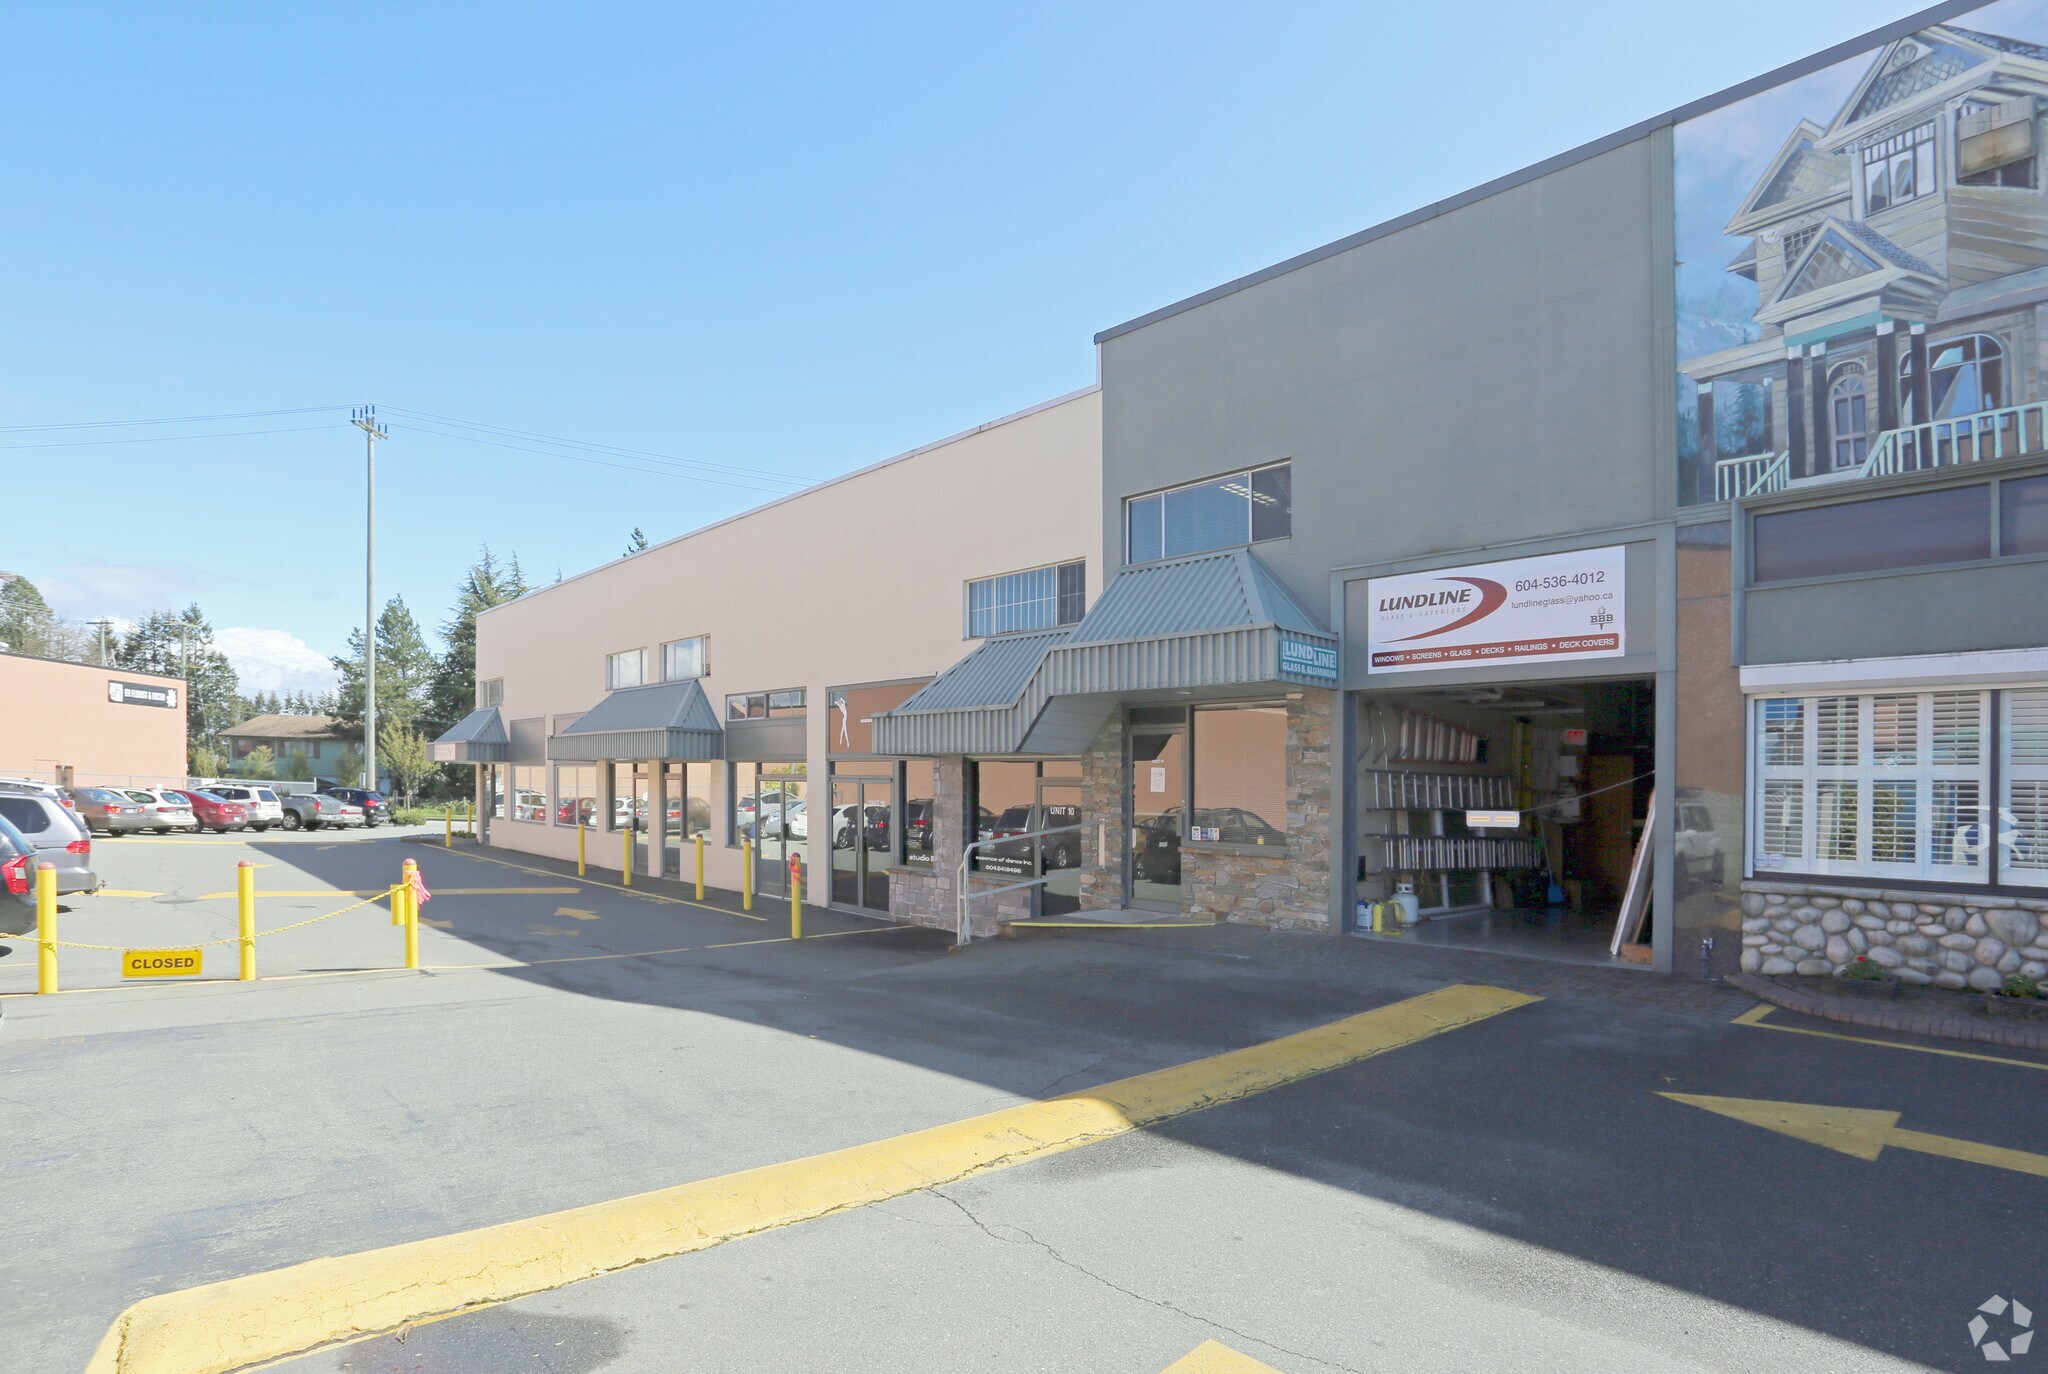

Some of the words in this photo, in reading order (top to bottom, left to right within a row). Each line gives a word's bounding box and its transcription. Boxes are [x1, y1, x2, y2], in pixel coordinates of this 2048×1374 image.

[1515, 570, 1605, 592] 604-536-4012
[1379, 589, 1472, 612] LUNDLINE
[1511, 592, 1614, 609] lundlineglass@yahoo.ca
[1380, 613, 1405, 621] GLASS
[1420, 606, 1467, 617] EXTERIORS
[1590, 614, 1614, 623] BBB
[1374, 654, 1405, 663] WINDOWS
[1412, 652, 1442, 661] SCREENS
[1450, 649, 1472, 657] GLASS
[1481, 646, 1505, 655] DECKS
[1514, 642, 1548, 652] RAILINGS
[1559, 640, 1580, 649] DECK
[1582, 638, 1615, 647] COVERS
[1282, 661, 1301, 673] GLASS
[1306, 665, 1337, 679] ALUMINUM
[1050, 806, 1067, 815] UNIT
[1067, 807, 1075, 816] 10
[908, 853, 930, 862] studio
[1005, 857, 1023, 865] dance
[131, 957, 195, 969] CLOSED
